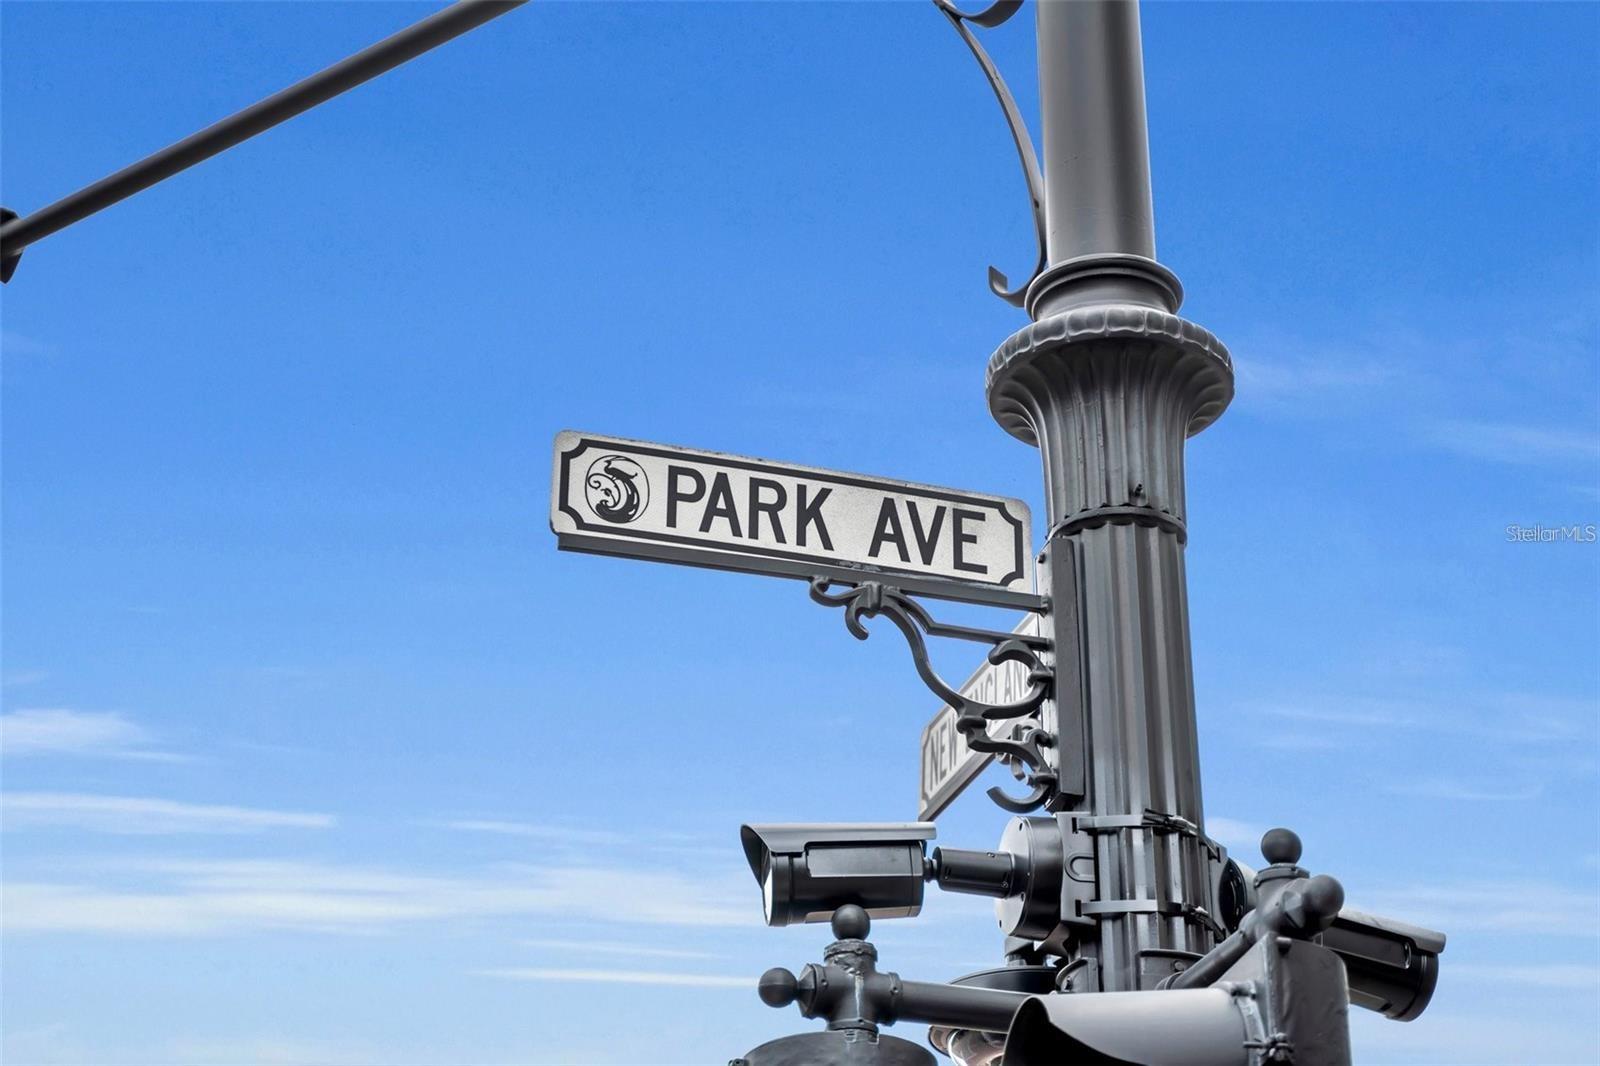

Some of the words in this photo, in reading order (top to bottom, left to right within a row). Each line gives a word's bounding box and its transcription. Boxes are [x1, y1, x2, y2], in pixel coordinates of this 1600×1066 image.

[665, 464, 835, 552] PARK
[867, 496, 989, 575] AVE
[930, 712, 958, 792] NEW
